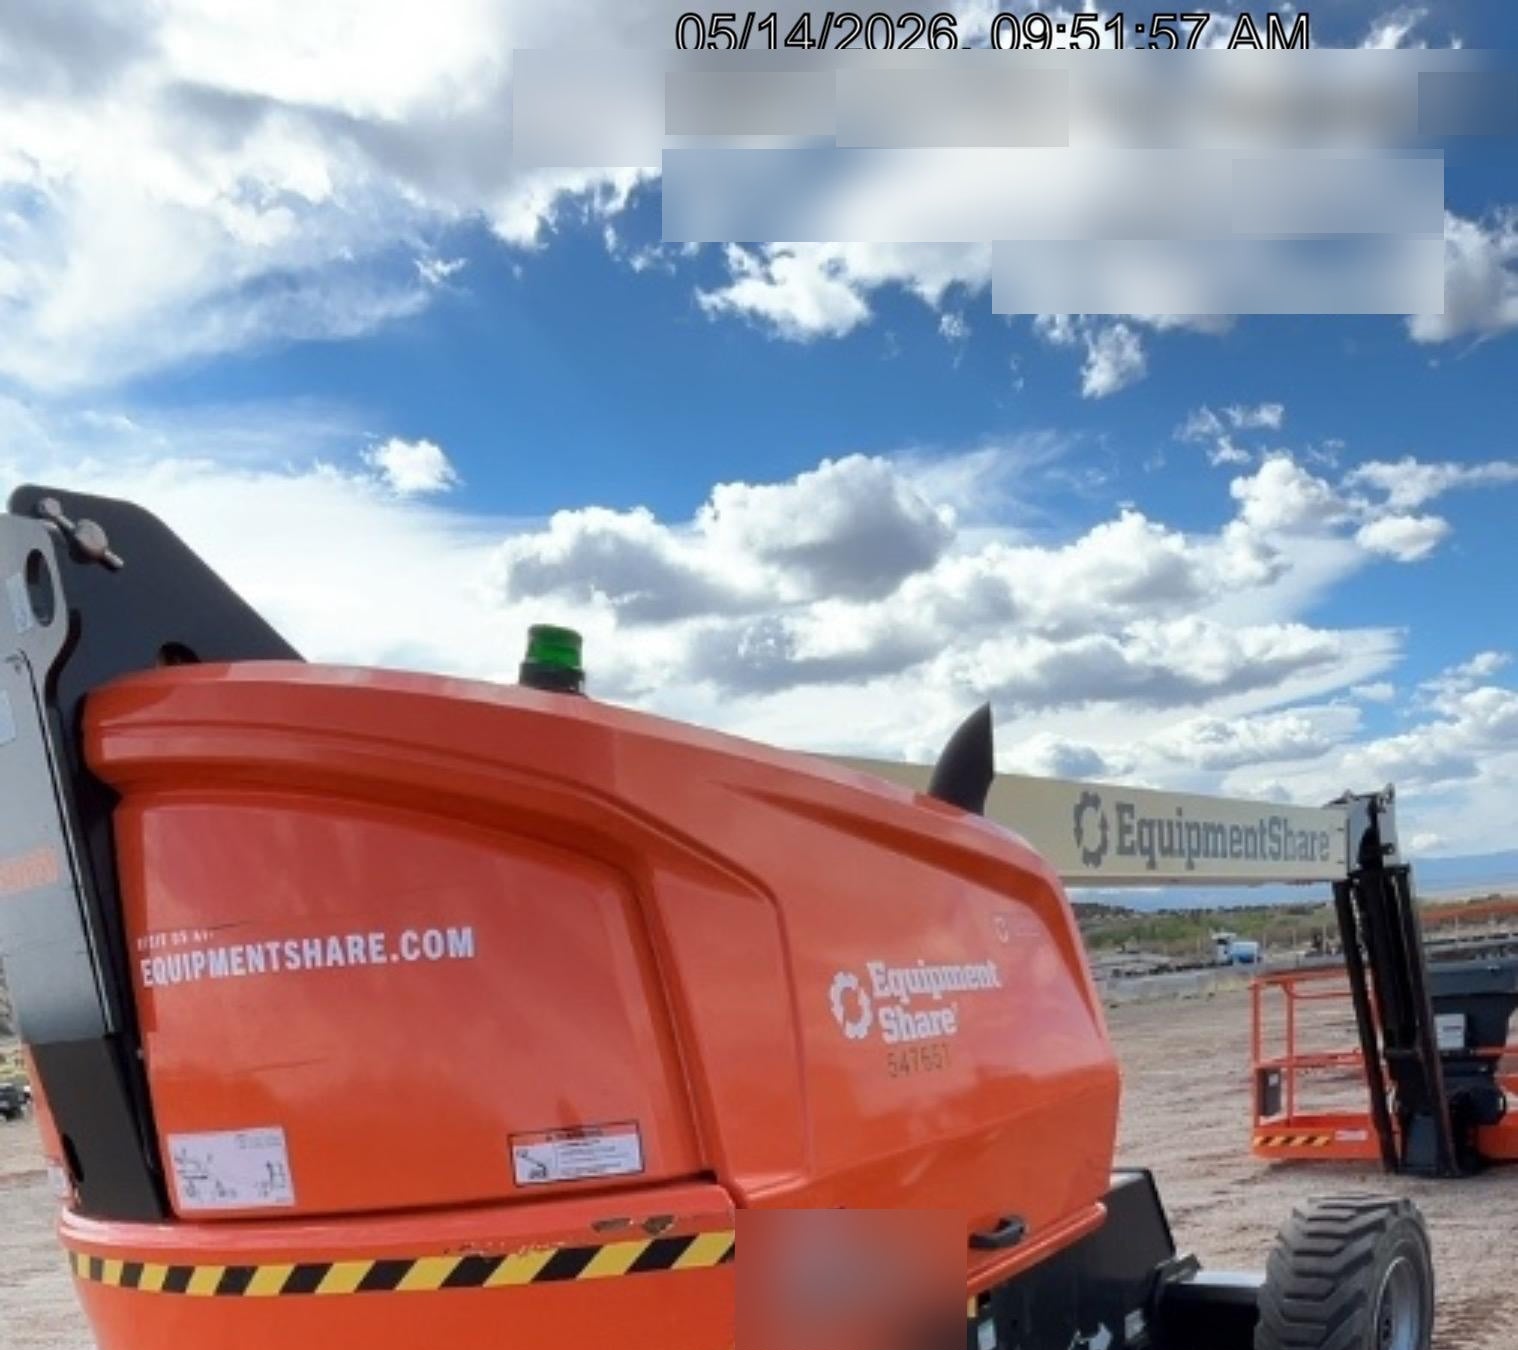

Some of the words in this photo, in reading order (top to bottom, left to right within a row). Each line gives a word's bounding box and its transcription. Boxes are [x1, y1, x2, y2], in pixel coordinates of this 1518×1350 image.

[1115, 802, 1330, 870] EquipmentShare
[140, 926, 474, 987] EQUIPMENTSHARE.COM
[866, 959, 1002, 1005] Equipment
